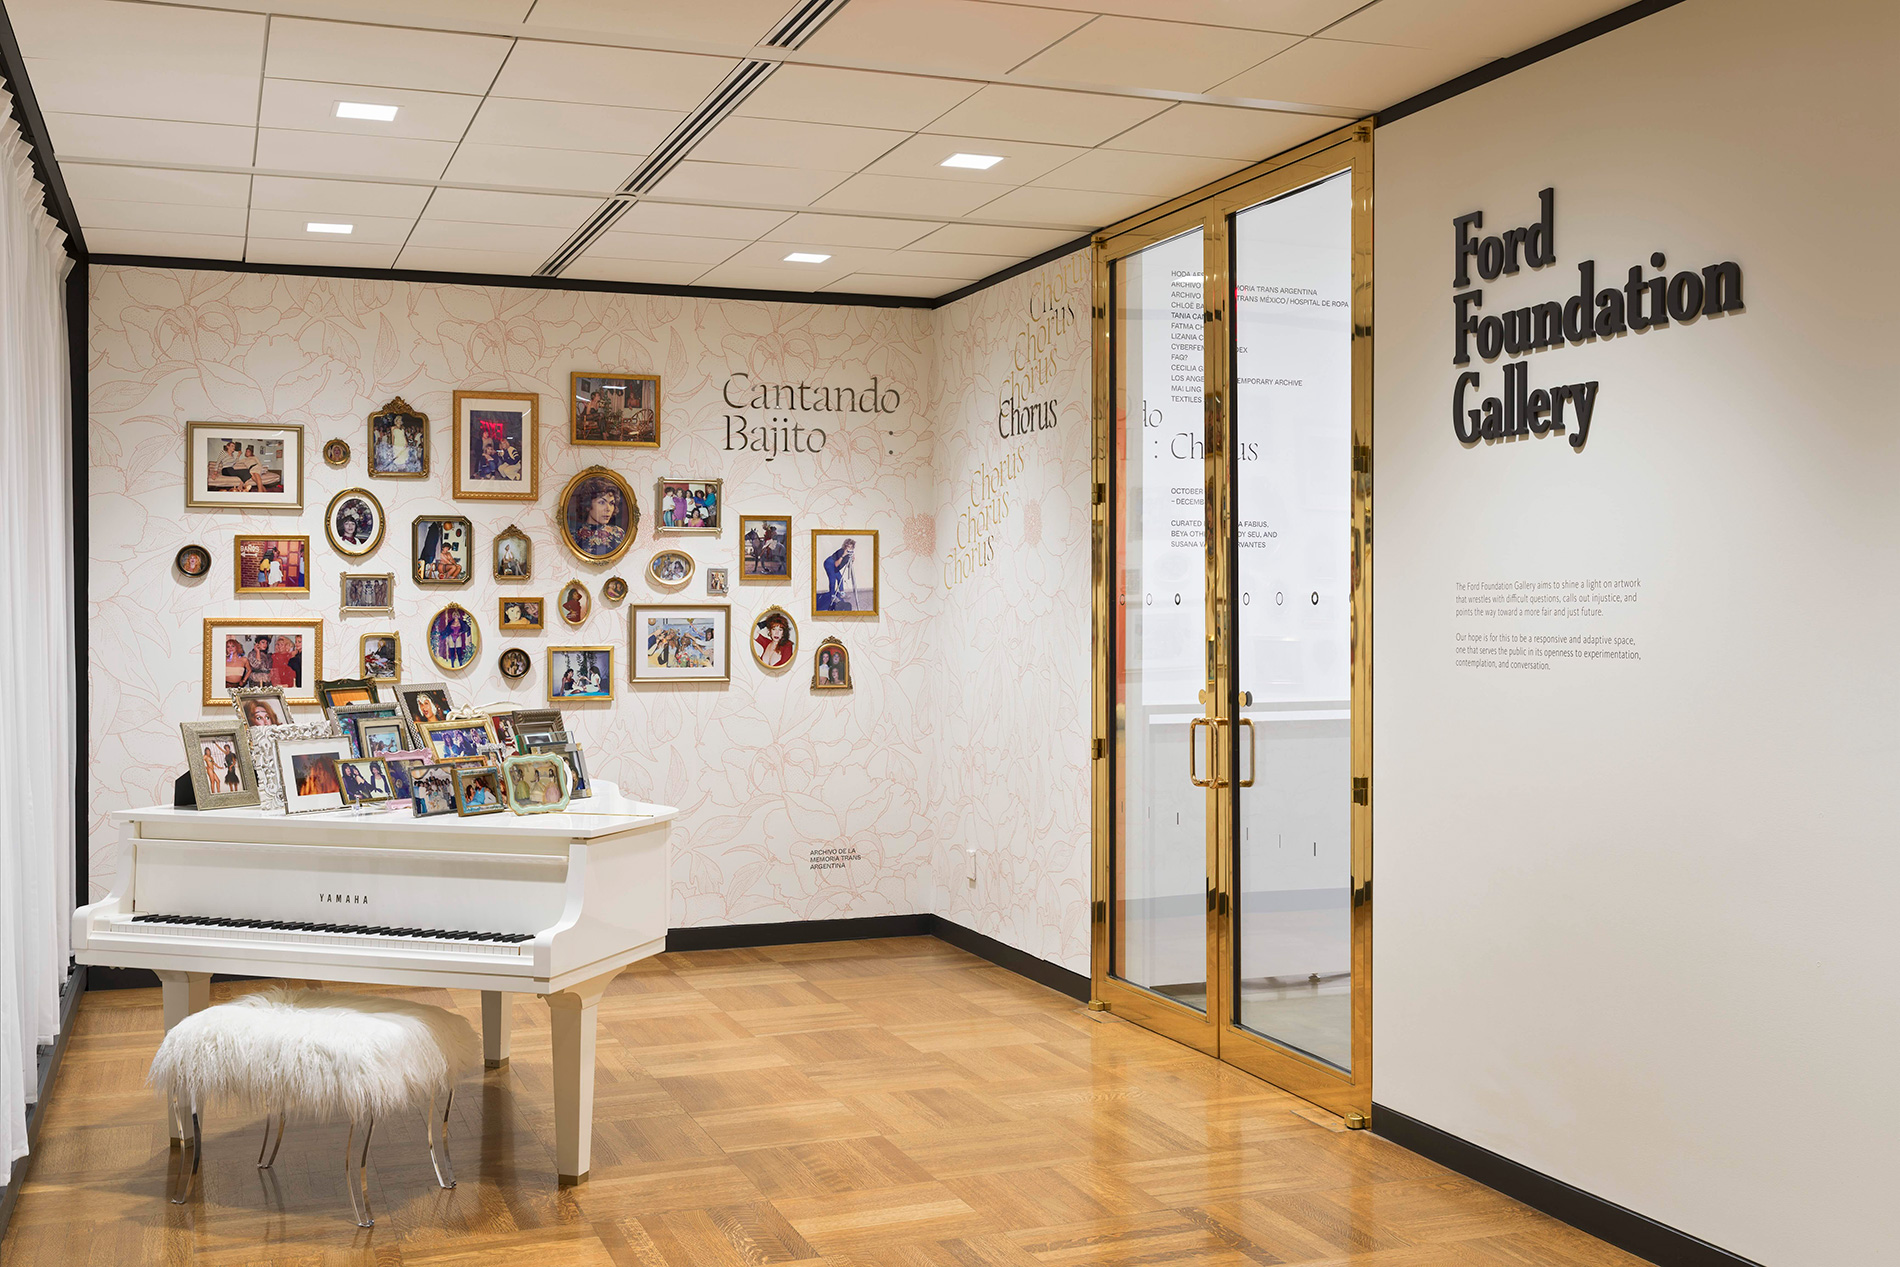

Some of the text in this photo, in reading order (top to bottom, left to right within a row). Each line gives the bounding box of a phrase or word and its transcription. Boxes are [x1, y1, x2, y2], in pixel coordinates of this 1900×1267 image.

[1453, 187, 1556, 288] Ford
[1171, 291, 1201, 299] ARCHIVO
[1257, 286, 1279, 294] TRANS
[1280, 287, 1318, 296] ARGENTINA
[1453, 251, 1744, 365] Foundation
[1171, 322, 1194, 330] FATMA
[1014, 297, 1074, 371] Chorus
[1171, 333, 1197, 341] LIZANIA
[999, 347, 1057, 418] Chorus
[1237, 377, 1274, 385] EMPORARY
[1274, 379, 1303, 387] ARCHIVE
[723, 372, 900, 414] Cantando
[1171, 395, 1202, 403] TEXTILES
[1453, 360, 1599, 448] Gallery
[999, 397, 1058, 439] Chorus
[722, 415, 827, 462] Bajito
[970, 445, 1024, 508] Chorus
[957, 491, 1009, 549] Chorus
[944, 535, 995, 590] Chorus
[1456, 582, 1466, 591] The
[1467, 582, 1480, 591] Ford
[1481, 581, 1513, 591] Foundation
[1514, 580, 1536, 592] Gallery
[1537, 581, 1551, 590] aims
[1553, 581, 1560, 590] to
[1562, 580, 1579, 589] shine
[1586, 579, 1602, 592] light
[1603, 581, 1612, 589] on
[1613, 578, 1641, 589] artwork
[1456, 592, 1637, 605] that wrestles with difficult questions, calls out injustice, and
[1456, 608, 1473, 618] points
[1474, 607, 1484, 616] the
[1484, 609, 1496, 618] way
[1497, 607, 1518, 616] toward
[1541, 607, 1552, 616] fair
[1553, 607, 1566, 616] and
[1566, 608, 1580, 618] just
[1581, 607, 1603, 617] future.
[1455, 632, 1467, 642] Our
[1468, 633, 1482, 643] hope
[1483, 633, 1489, 642] is
[1489, 633, 1498, 642] for
[1499, 633, 1511, 642] this
[1519, 633, 1527, 643] be
[1533, 635, 1568, 645] responsive
[1568, 635, 1581, 644] and
[1583, 635, 1612, 646] adaptive
[1614, 637, 1636, 647] space,
[1455, 645, 1641, 660] one that serves the public in its openness to experimentation,
[1455, 659, 1551, 670] contemplation, and conversation.
[319, 893, 368, 904] YAMAHA
